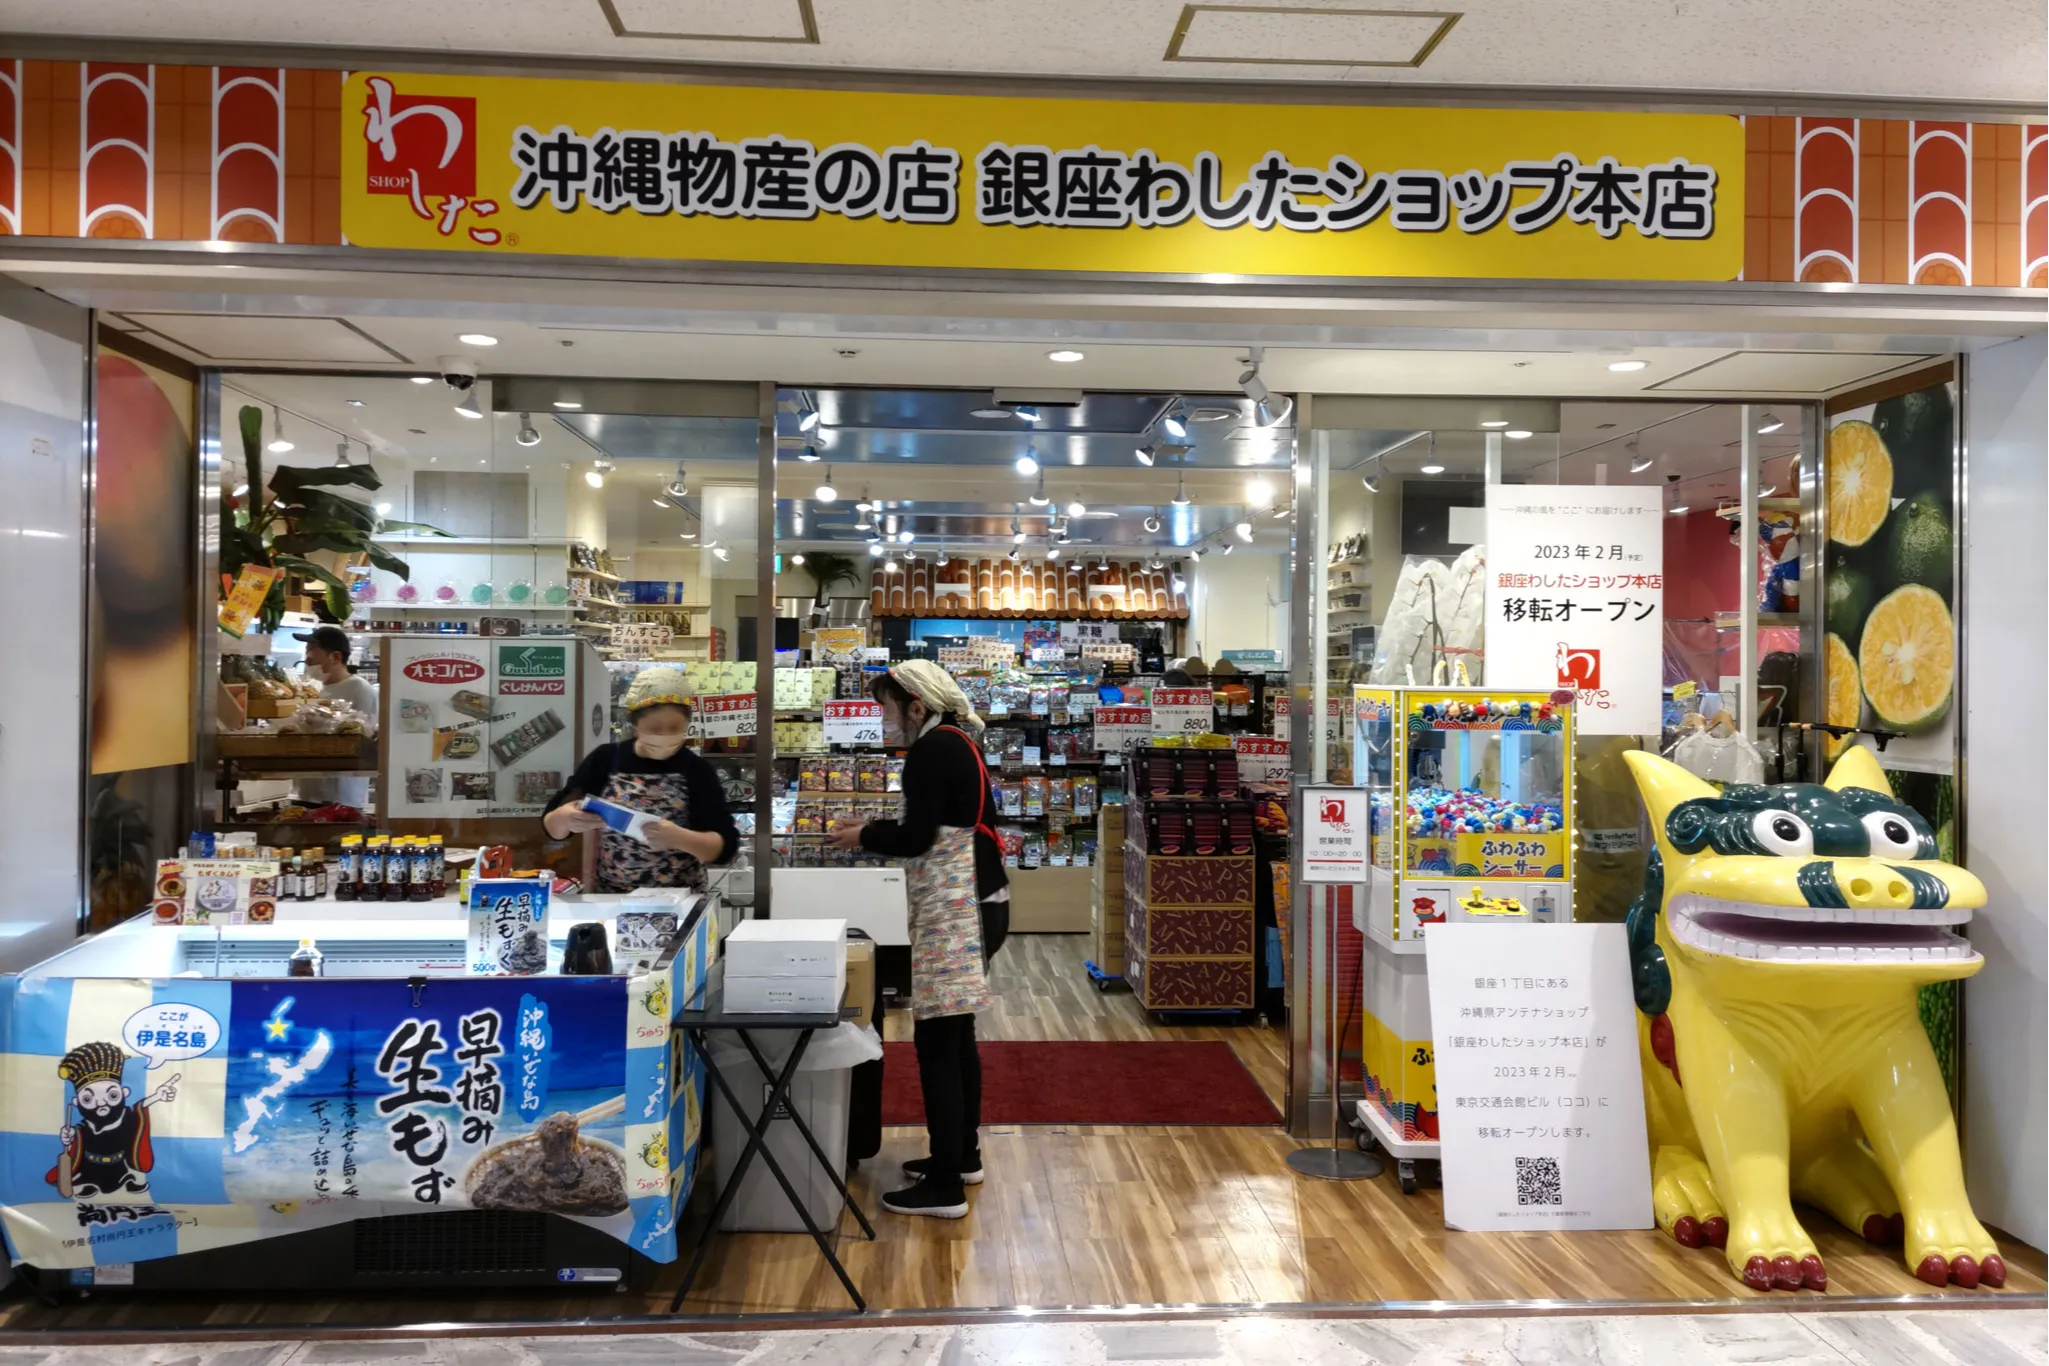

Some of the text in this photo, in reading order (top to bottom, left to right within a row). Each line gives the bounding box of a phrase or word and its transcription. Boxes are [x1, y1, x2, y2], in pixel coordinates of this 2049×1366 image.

[362, 76, 502, 246] わした
[369, 175, 410, 188] SHOP
[513, 126, 1717, 238] 沖縄物産の店 銀座わしたショップ本店
[1498, 573, 1662, 589] 銀座わしたショップ本店
[1503, 598, 1656, 622] 移転オープン
[614, 626, 670, 638] ちんすこう
[1077, 625, 1103, 638] 黒糖
[411, 664, 478, 678] オキコパン
[500, 682, 564, 692] ぐしけんパン
[1153, 693, 1211, 704] おすすめ品
[825, 705, 881, 716] おすすめ品
[1096, 712, 1151, 723] おすすめ品
[1481, 840, 1546, 857] ふわふわ
[1483, 860, 1543, 875] シーサー
[495, 896, 517, 967] 生もずく
[158, 1011, 189, 1022] ここが
[1460, 1006, 1589, 1018] 沖縄県アンテナショップ
[136, 1030, 207, 1049] 伊是名島
[1448, 1036, 1607, 1049] 「銀座わしたショップ本店」が
[456, 1011, 501, 1147] 早摘み
[1455, 1096, 1609, 1109] 東京交通会館ビル（ココ）に
[1477, 1126, 1592, 1139] 移転オープンします。
